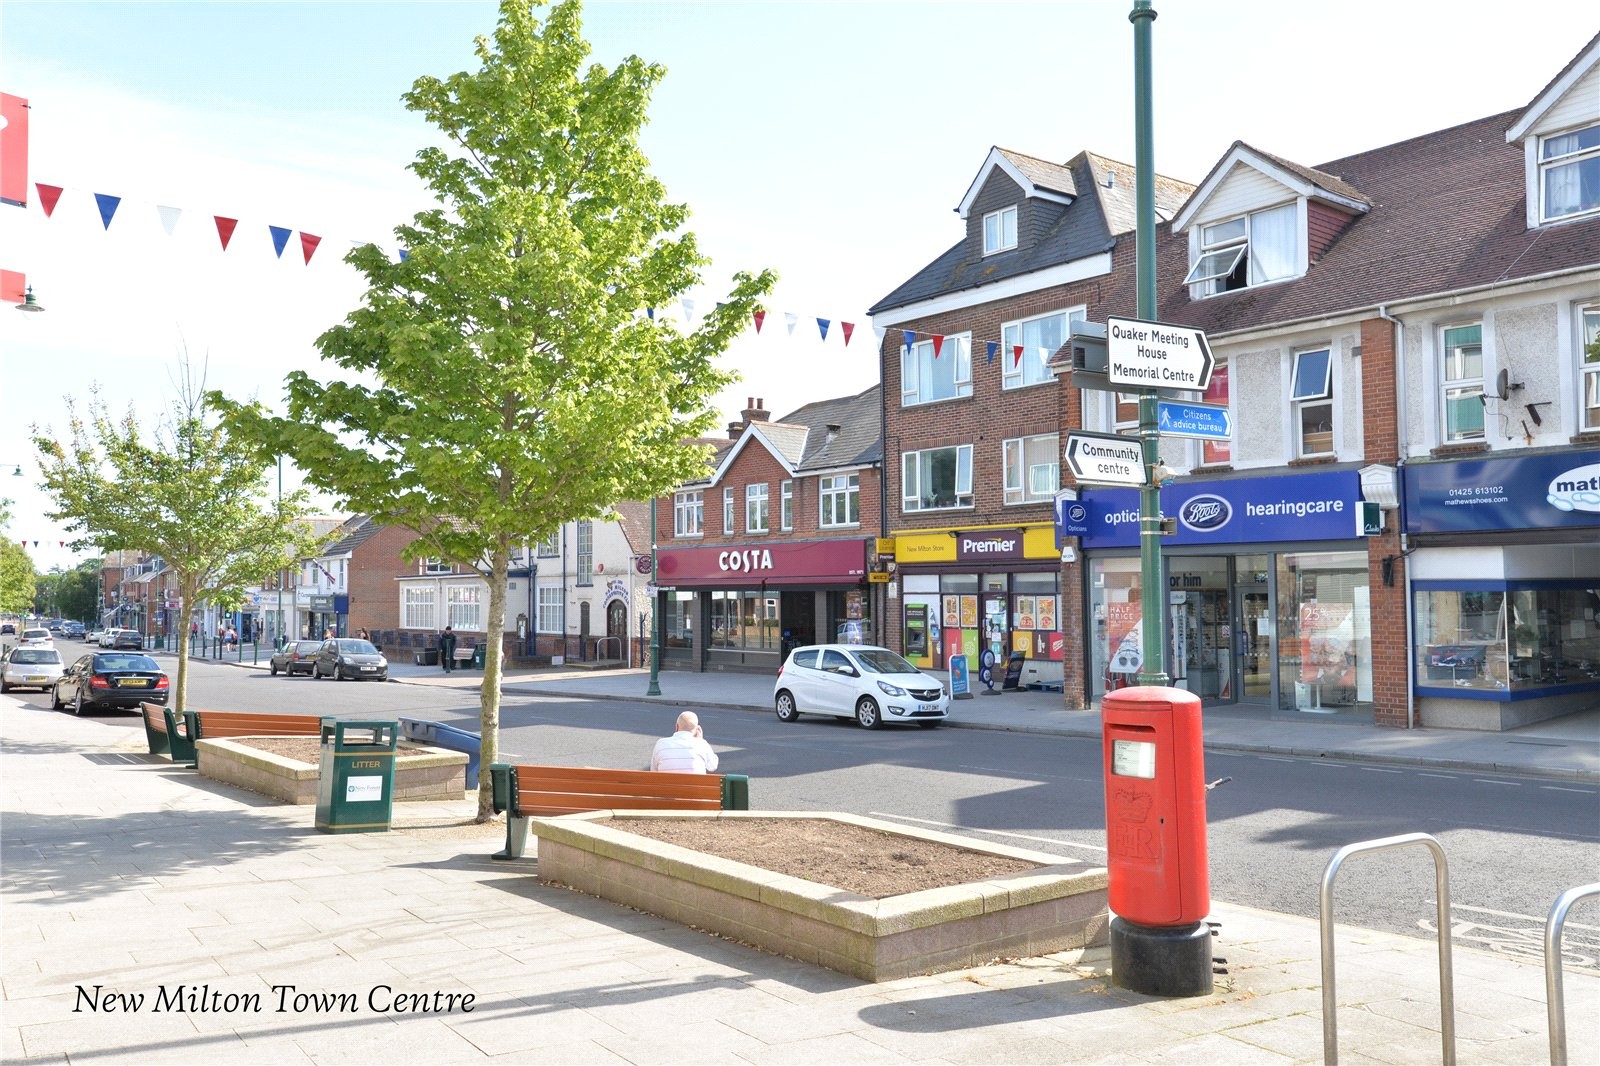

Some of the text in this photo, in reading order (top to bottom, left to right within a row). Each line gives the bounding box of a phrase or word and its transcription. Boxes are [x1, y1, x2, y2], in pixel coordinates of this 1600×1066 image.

[1112, 325, 1189, 348] Quaker Meeting
[1137, 345, 1167, 359] House
[1113, 363, 1194, 382] Memorial Centre
[1183, 409, 1211, 421] Citizens
[1173, 420, 1223, 432] advice bureau
[1082, 442, 1139, 462] Community
[1097, 462, 1130, 475] centre
[1449, 486, 1504, 496] 01425 613102
[1246, 500, 1344, 517] hearingcare
[1444, 496, 1509, 506] mathewsshoes.com
[1104, 508, 1164, 526] opticis
[1187, 502, 1221, 523] Boots
[963, 538, 1016, 553] Premier
[718, 549, 774, 573] COSTA
[1183, 572, 1201, 587] him
[1304, 607, 1329, 621] 25%
[351, 760, 380, 768] LITTER
